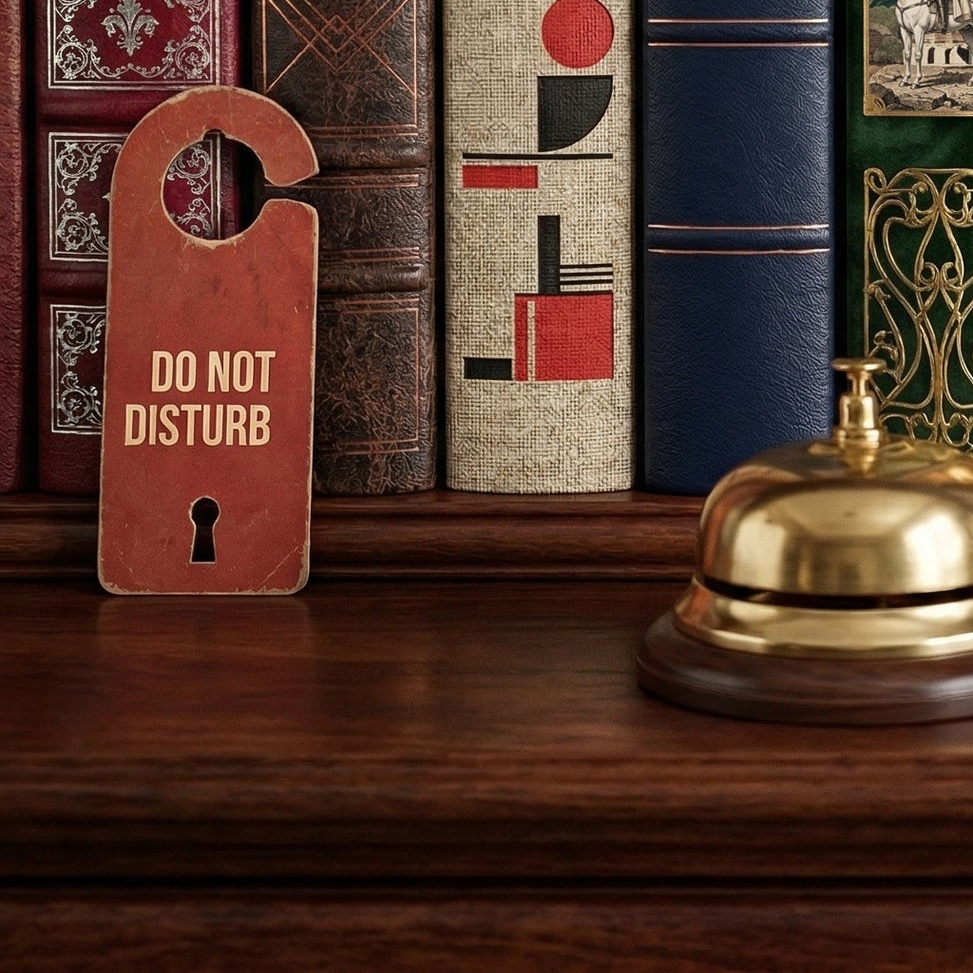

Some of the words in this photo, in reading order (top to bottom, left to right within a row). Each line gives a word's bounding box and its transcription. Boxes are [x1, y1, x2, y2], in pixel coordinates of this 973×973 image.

[151, 350, 197, 393] DO
[207, 350, 276, 393] NOT
[124, 404, 271, 446] DISTURB
